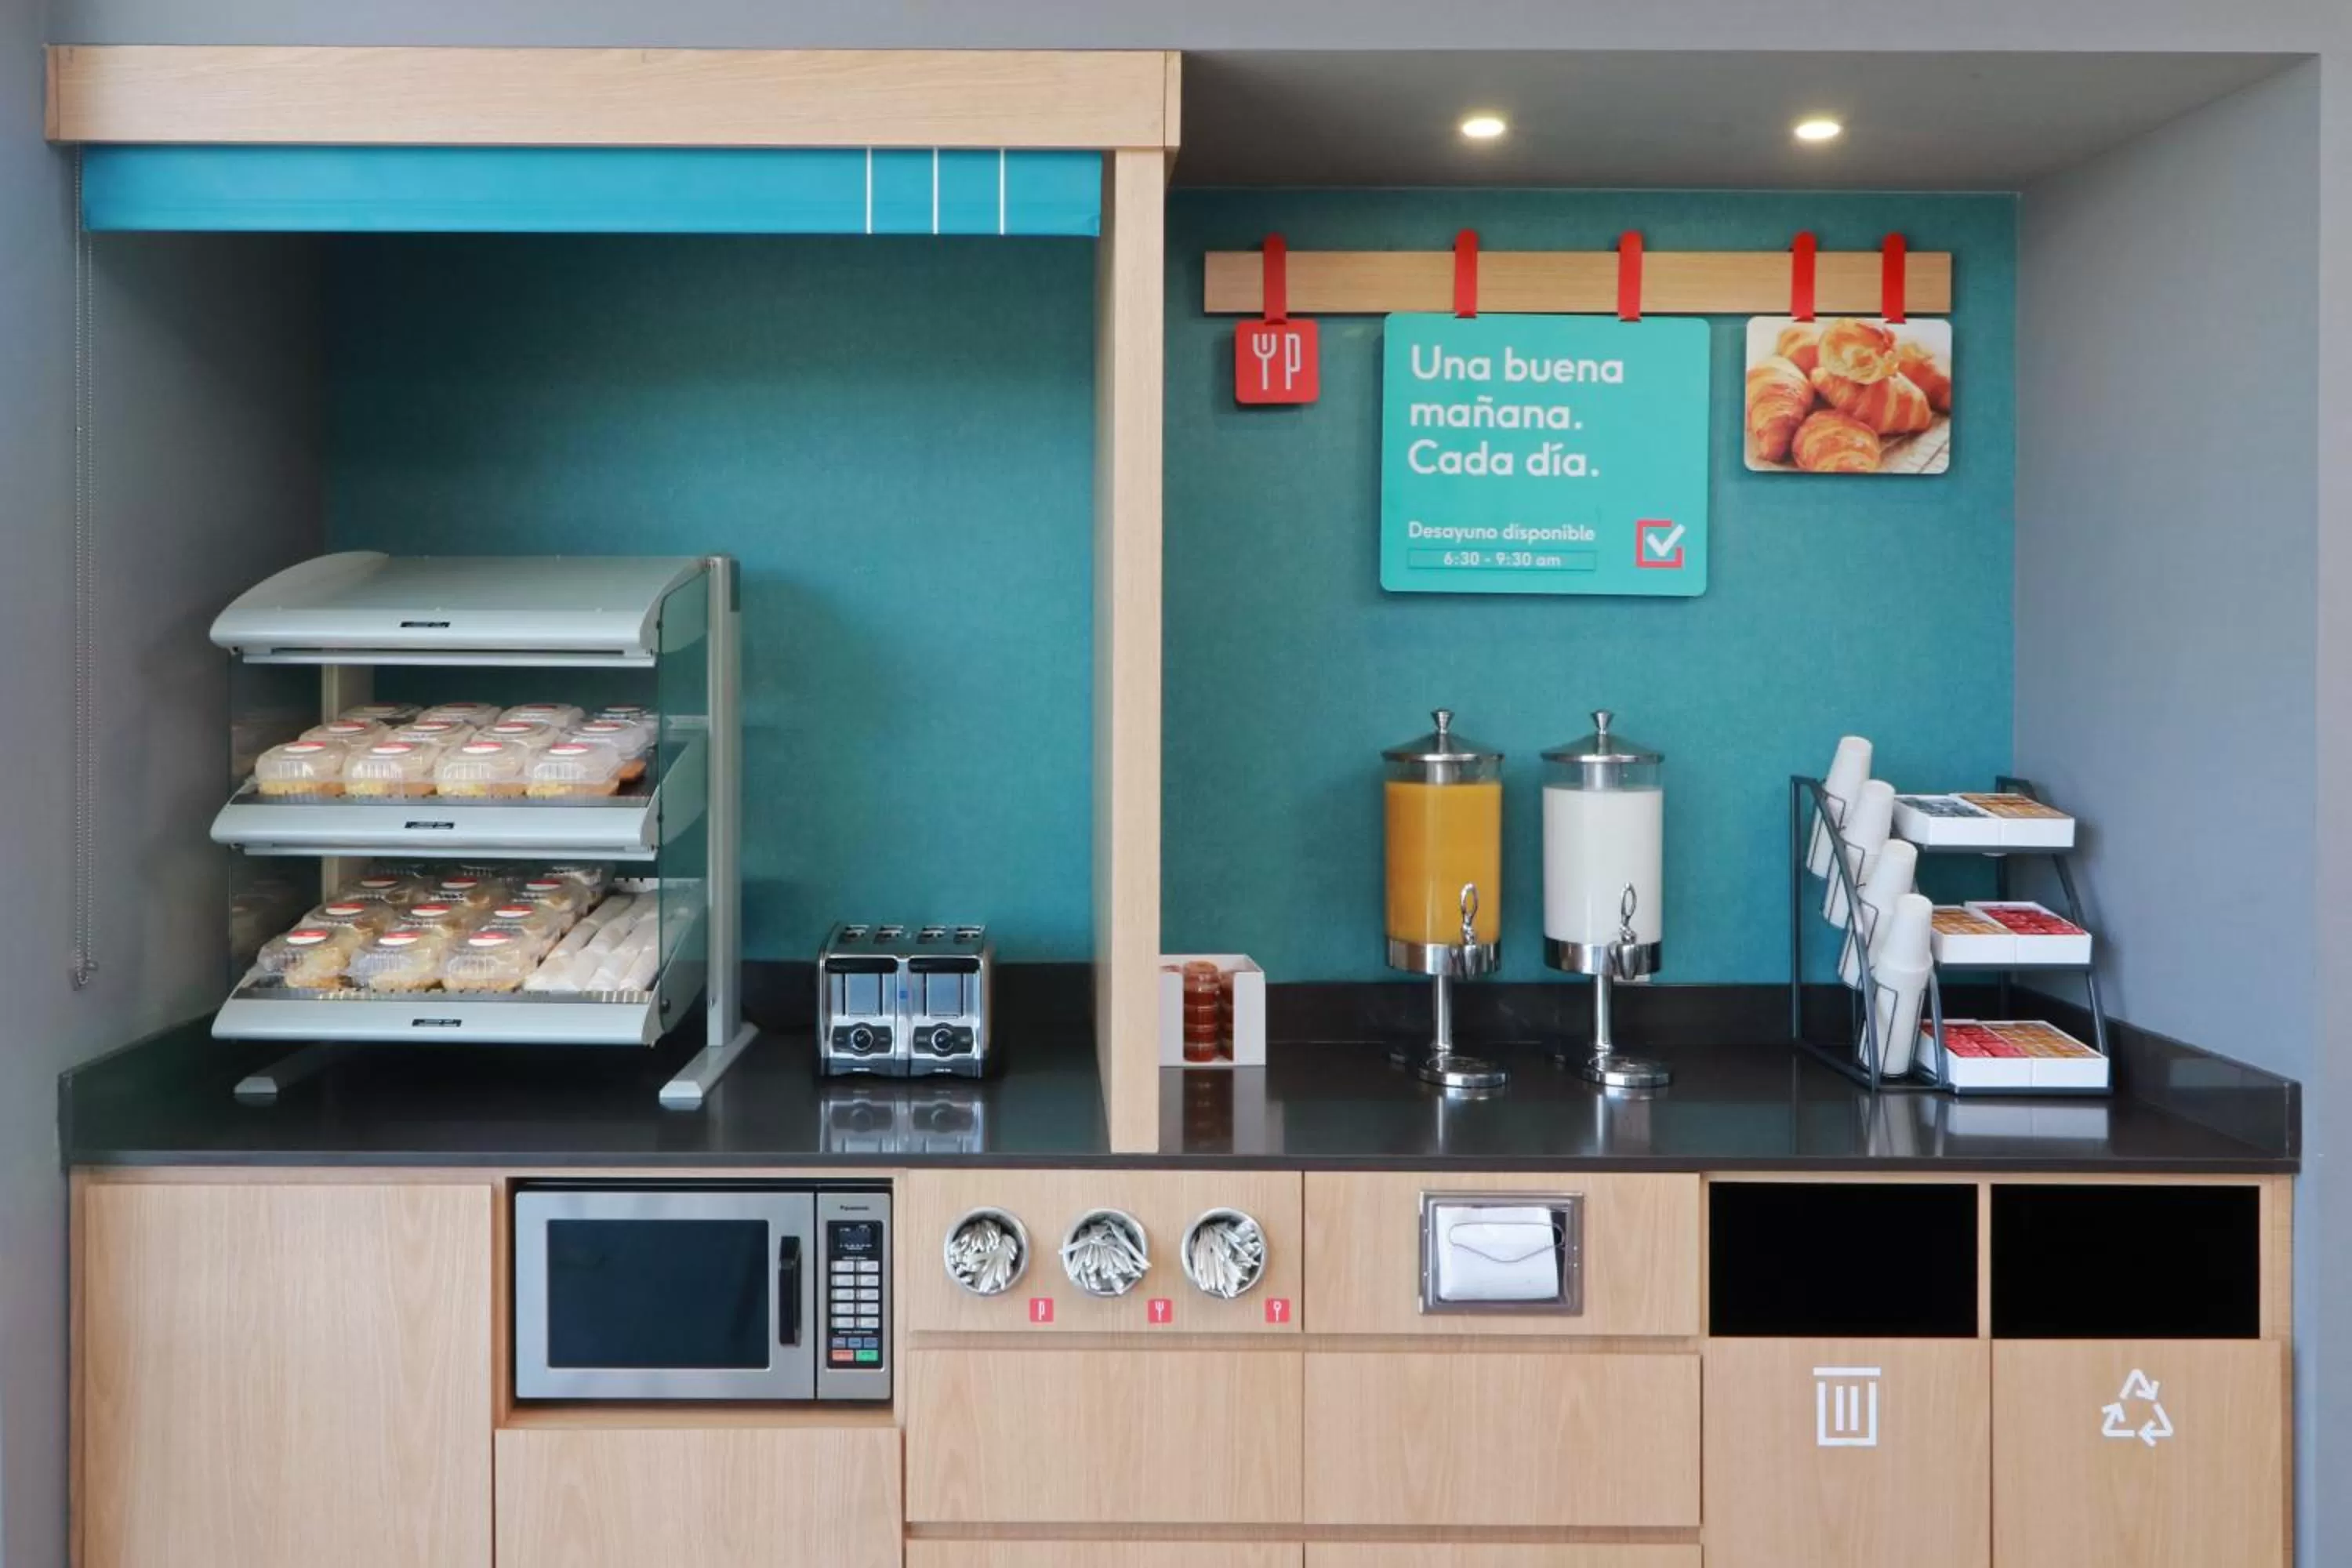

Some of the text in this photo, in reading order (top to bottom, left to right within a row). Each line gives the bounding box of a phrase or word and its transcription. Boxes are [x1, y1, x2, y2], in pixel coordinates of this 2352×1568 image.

[1411, 344, 1624, 383] Una buena
[1410, 395, 1584, 430] mañana.
[1408, 438, 1600, 477] Cada día.
[1409, 521, 1595, 544] Desayuno disponible
[1444, 552, 1480, 566] 6:30
[1496, 552, 1532, 566] 9:30
[1536, 557, 1561, 566] am
